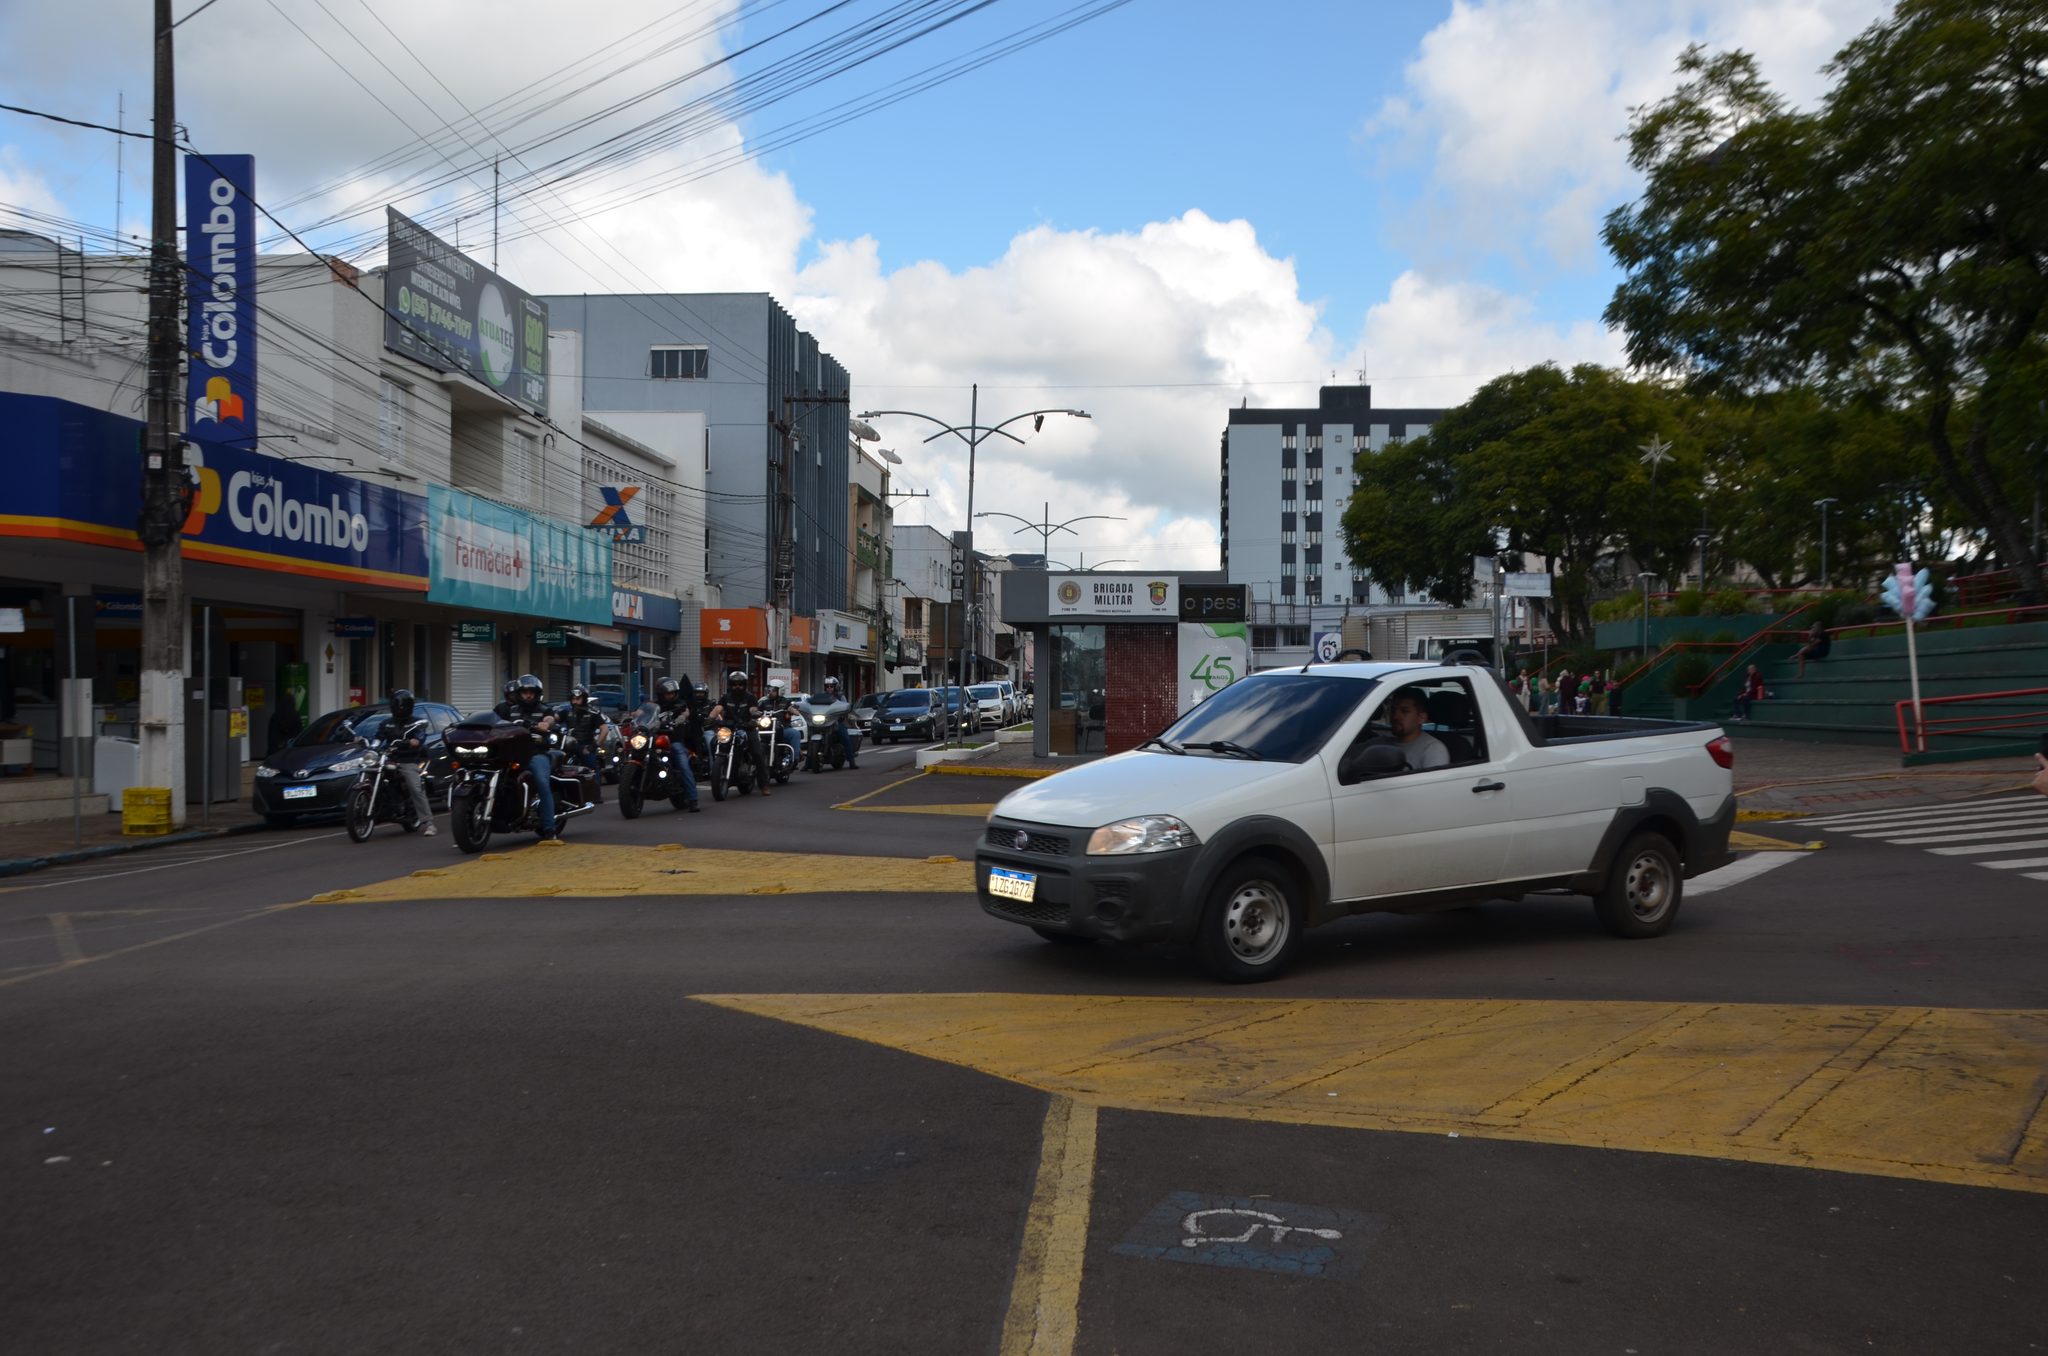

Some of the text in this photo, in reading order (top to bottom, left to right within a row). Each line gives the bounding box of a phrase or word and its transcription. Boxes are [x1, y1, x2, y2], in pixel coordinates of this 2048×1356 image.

[202, 177, 238, 369] Colombo
[479, 318, 514, 350] ATUATEC
[228, 470, 369, 552] Colombo
[1093, 583, 1134, 594] BRIGADA
[1094, 595, 1133, 606] MILITAR
[612, 591, 644, 620] CAIXA
[1190, 654, 1235, 691] 45
